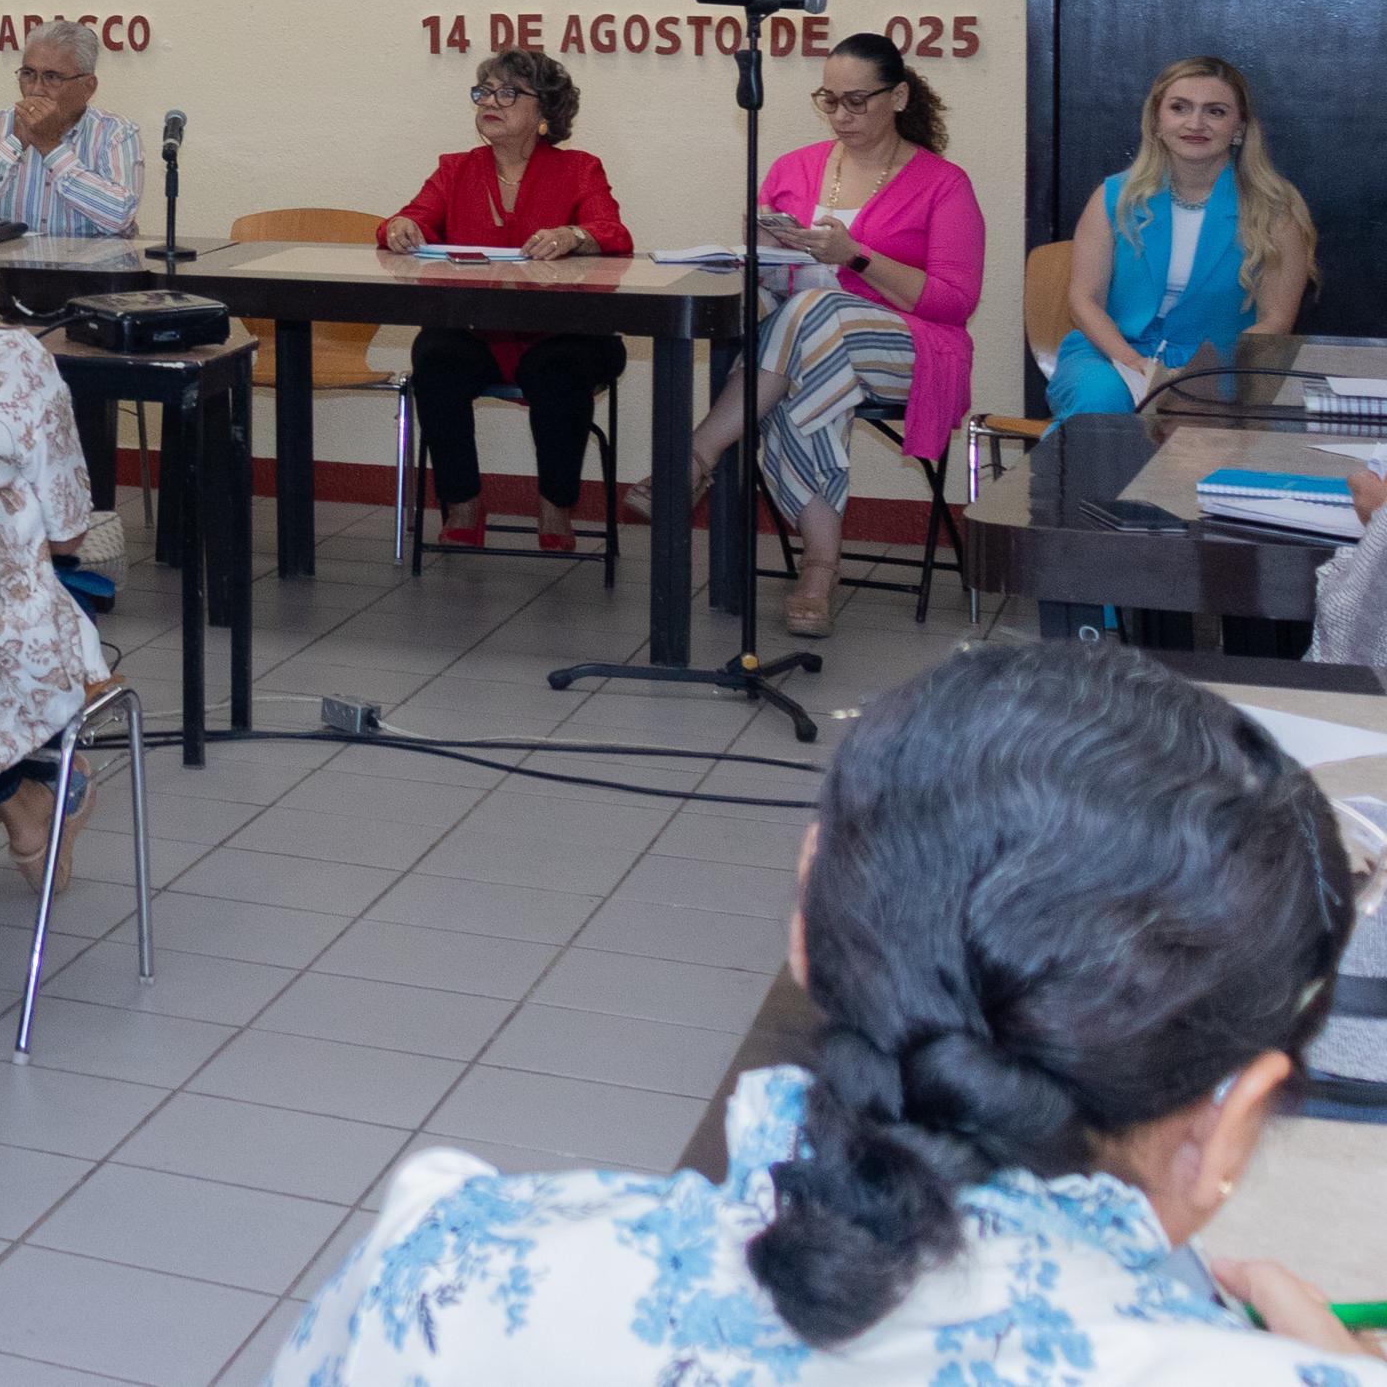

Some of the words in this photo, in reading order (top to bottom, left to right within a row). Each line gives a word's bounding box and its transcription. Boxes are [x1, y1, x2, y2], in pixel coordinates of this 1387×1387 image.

[421, 15, 471, 54] 14
[489, 13, 545, 54] DE
[560, 14, 742, 57] AGOSTO
[769, 16, 830, 57] DE
[883, 15, 981, 59] 025
